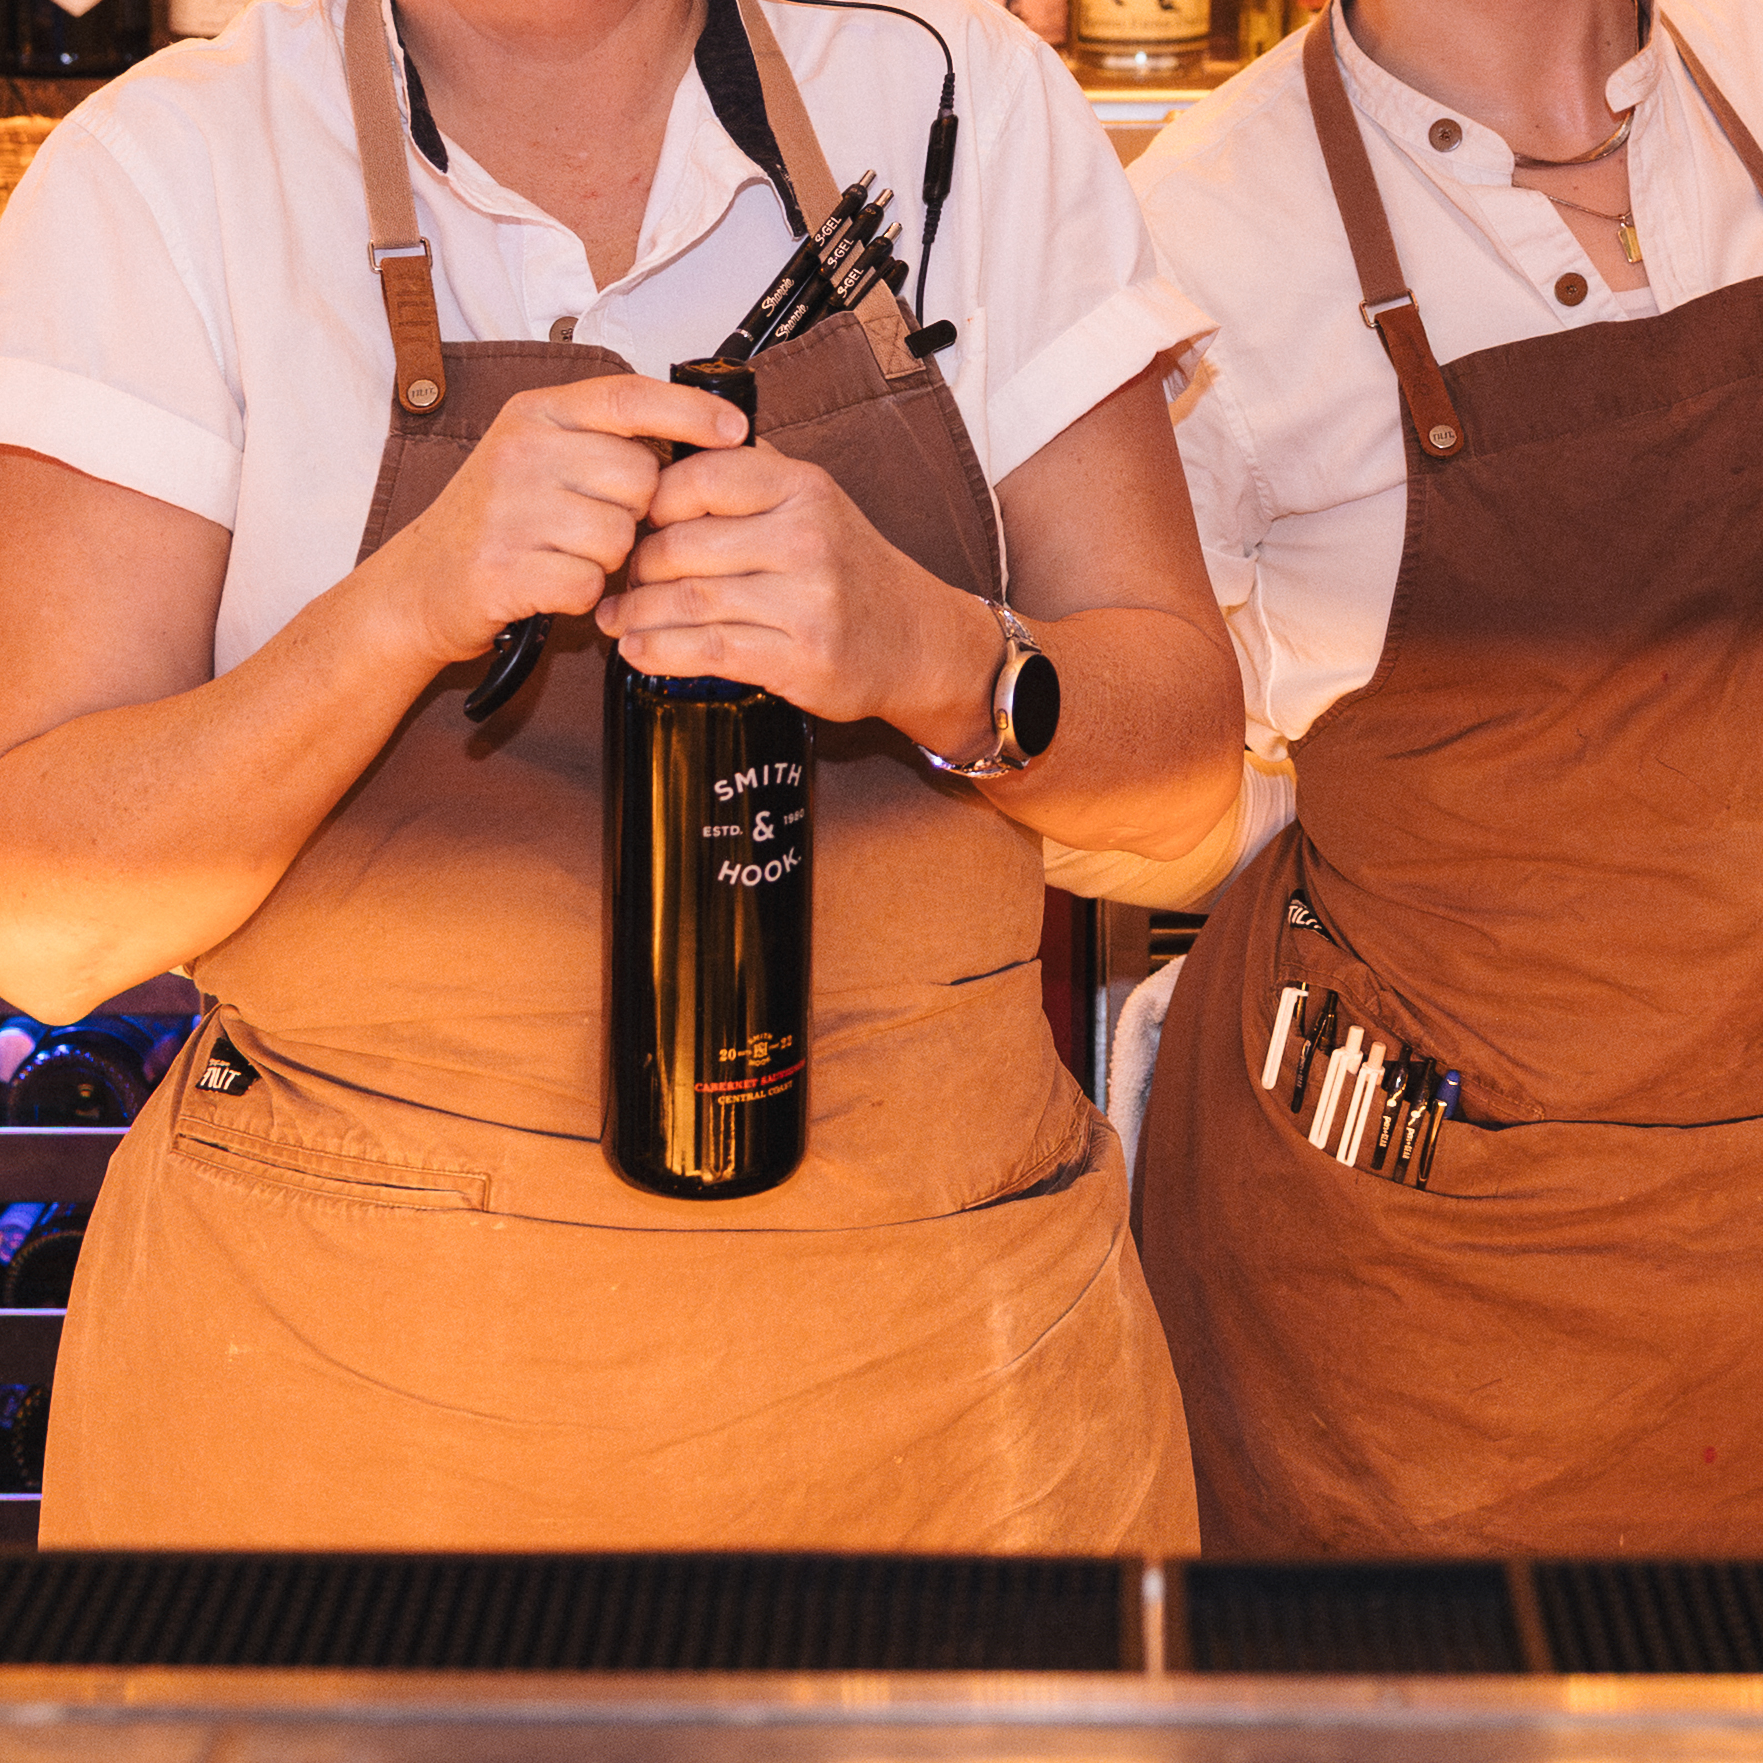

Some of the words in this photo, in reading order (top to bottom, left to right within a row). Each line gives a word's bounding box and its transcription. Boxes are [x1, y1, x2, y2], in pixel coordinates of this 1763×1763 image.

[761, 277, 796, 318] Sharpie
[775, 303, 810, 342] Sharpie
[714, 762, 803, 802] SMITH
[702, 824, 744, 838] ESTD.
[752, 810, 775, 842] &
[718, 1047, 737, 1063] 20
[694, 1078, 759, 1093] CABERNET
[717, 1090, 767, 1106] CENTRAL
